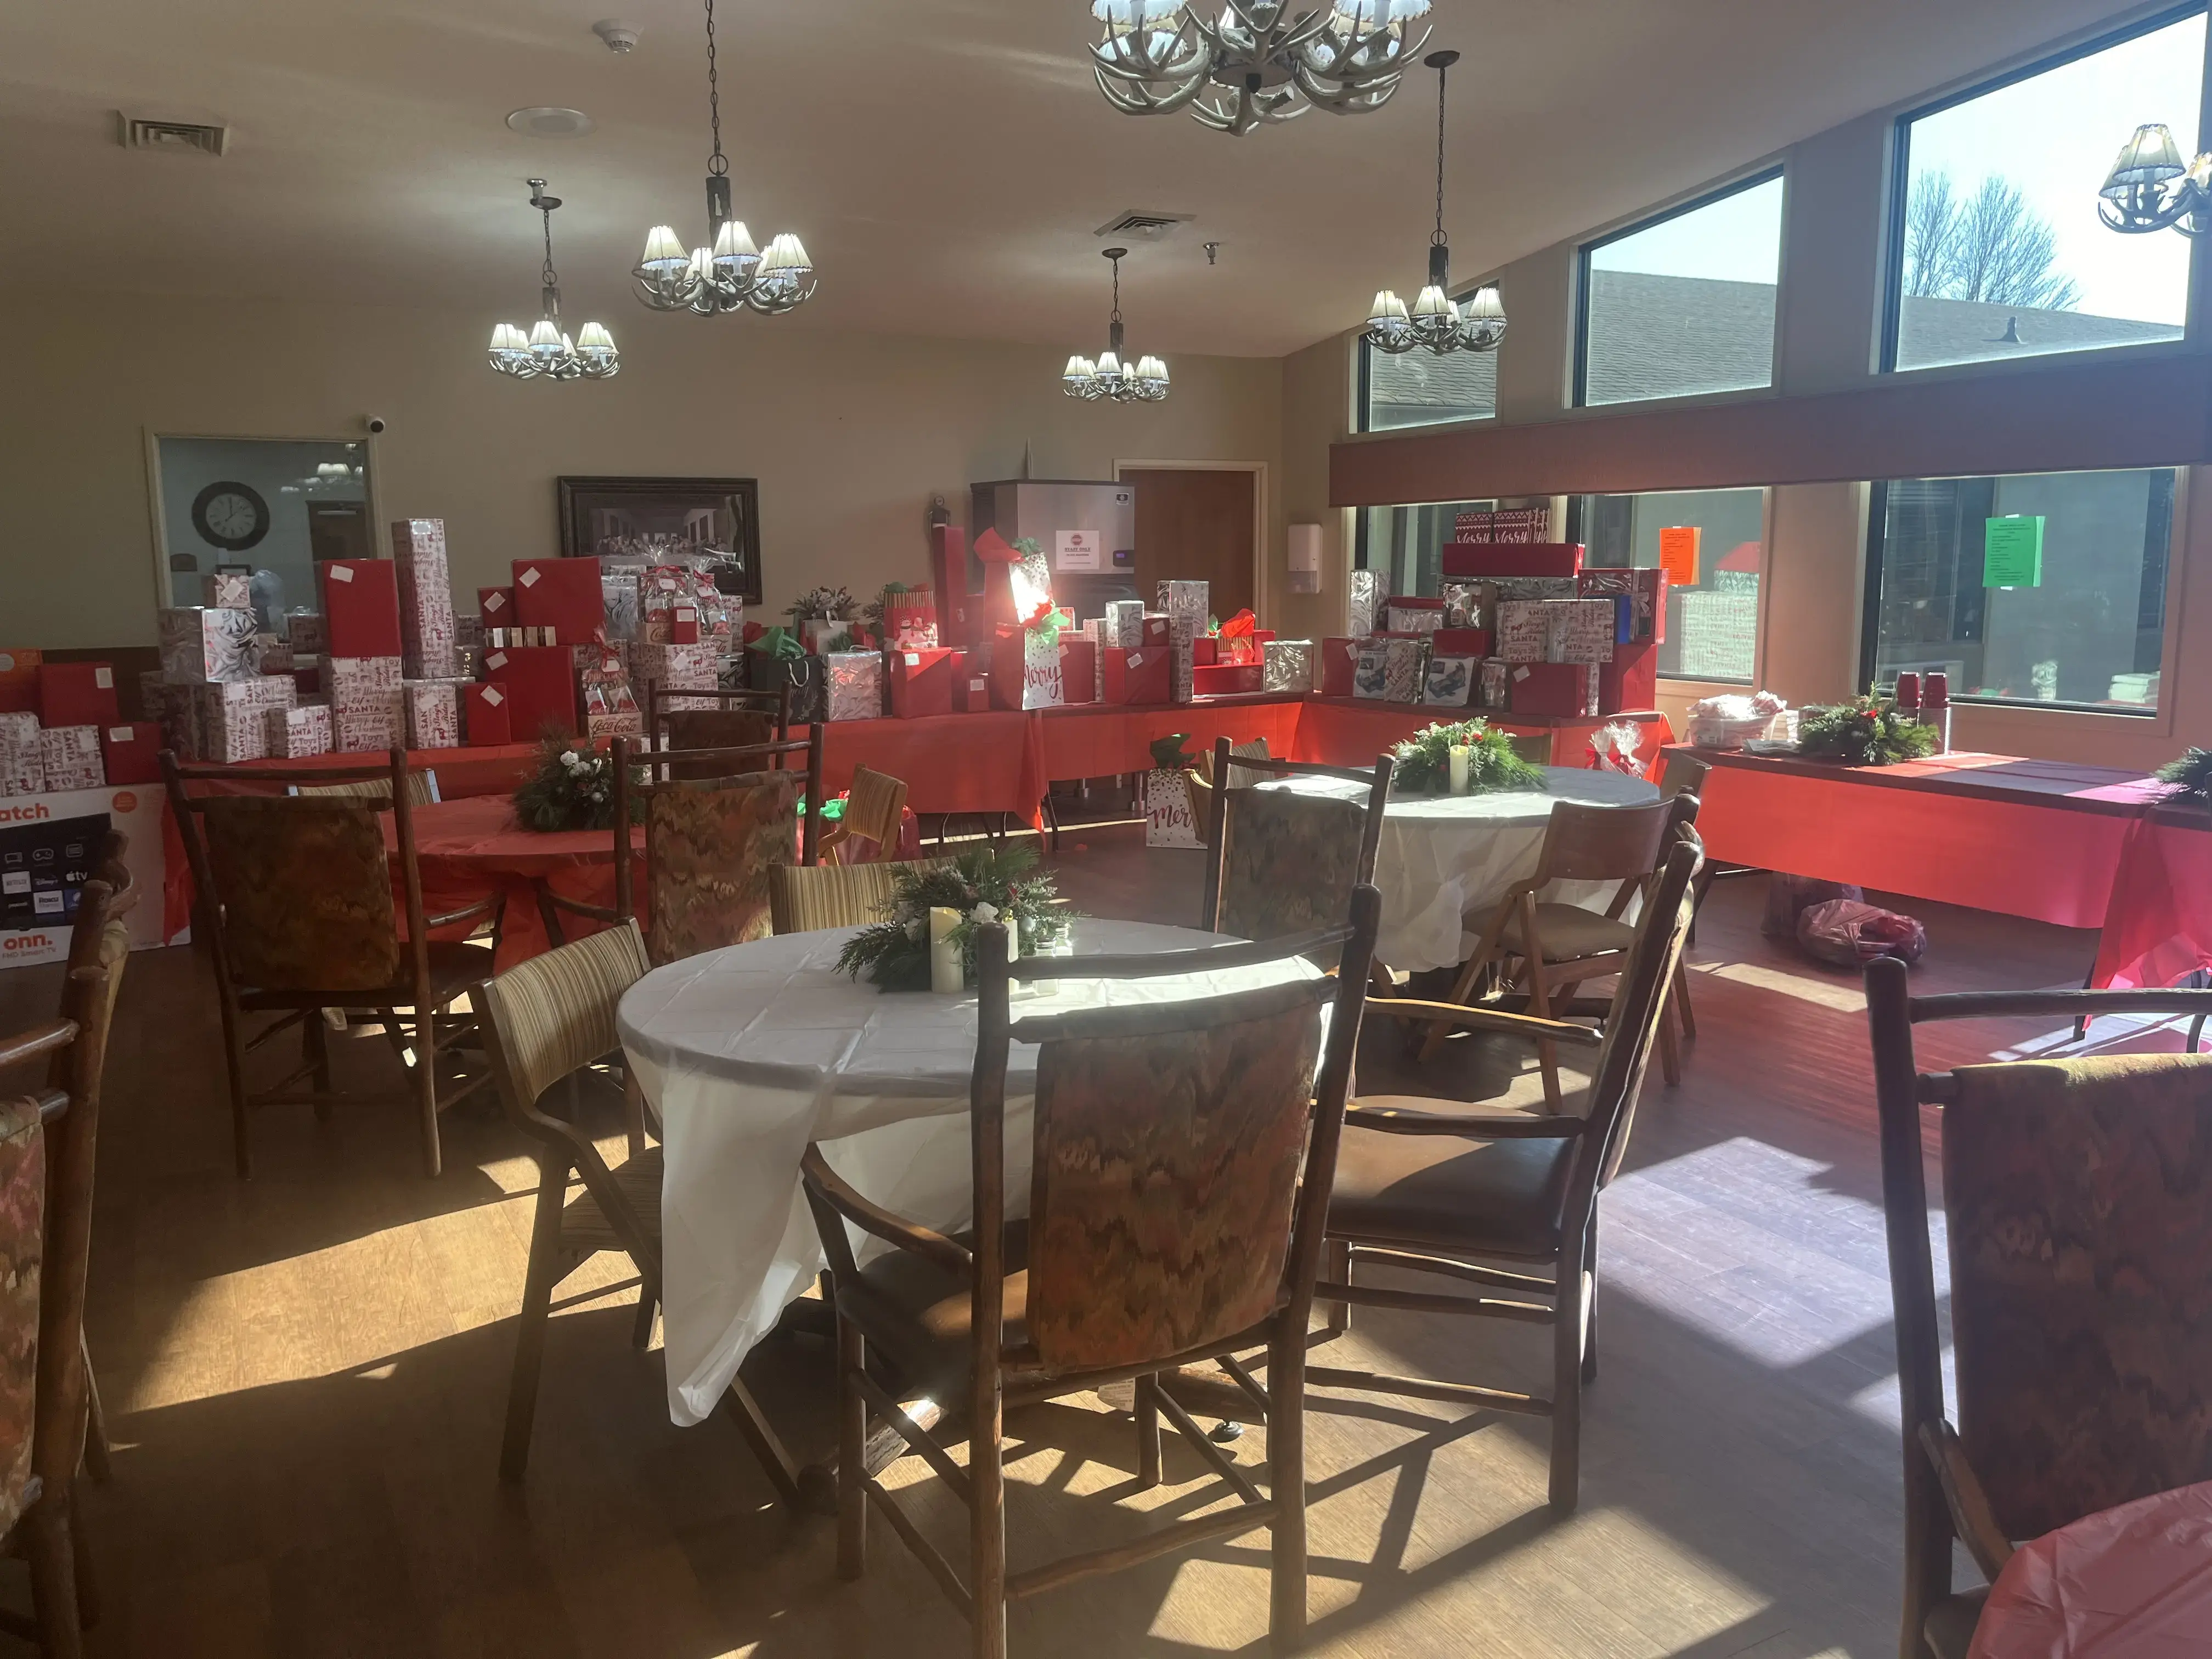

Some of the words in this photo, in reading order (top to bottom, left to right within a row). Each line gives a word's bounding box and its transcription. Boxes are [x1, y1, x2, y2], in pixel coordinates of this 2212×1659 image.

[1457, 532, 1491, 544] Merry
[1495, 531, 1528, 544] Merry
[417, 600, 426, 629] SANTA
[383, 658, 400, 667] Toy
[286, 728, 311, 736] SANTA
[63, 731, 76, 761] SANTA
[0, 803, 49, 822] atch
[1147, 804, 1192, 829] Mer
[4, 934, 53, 950] onn.
